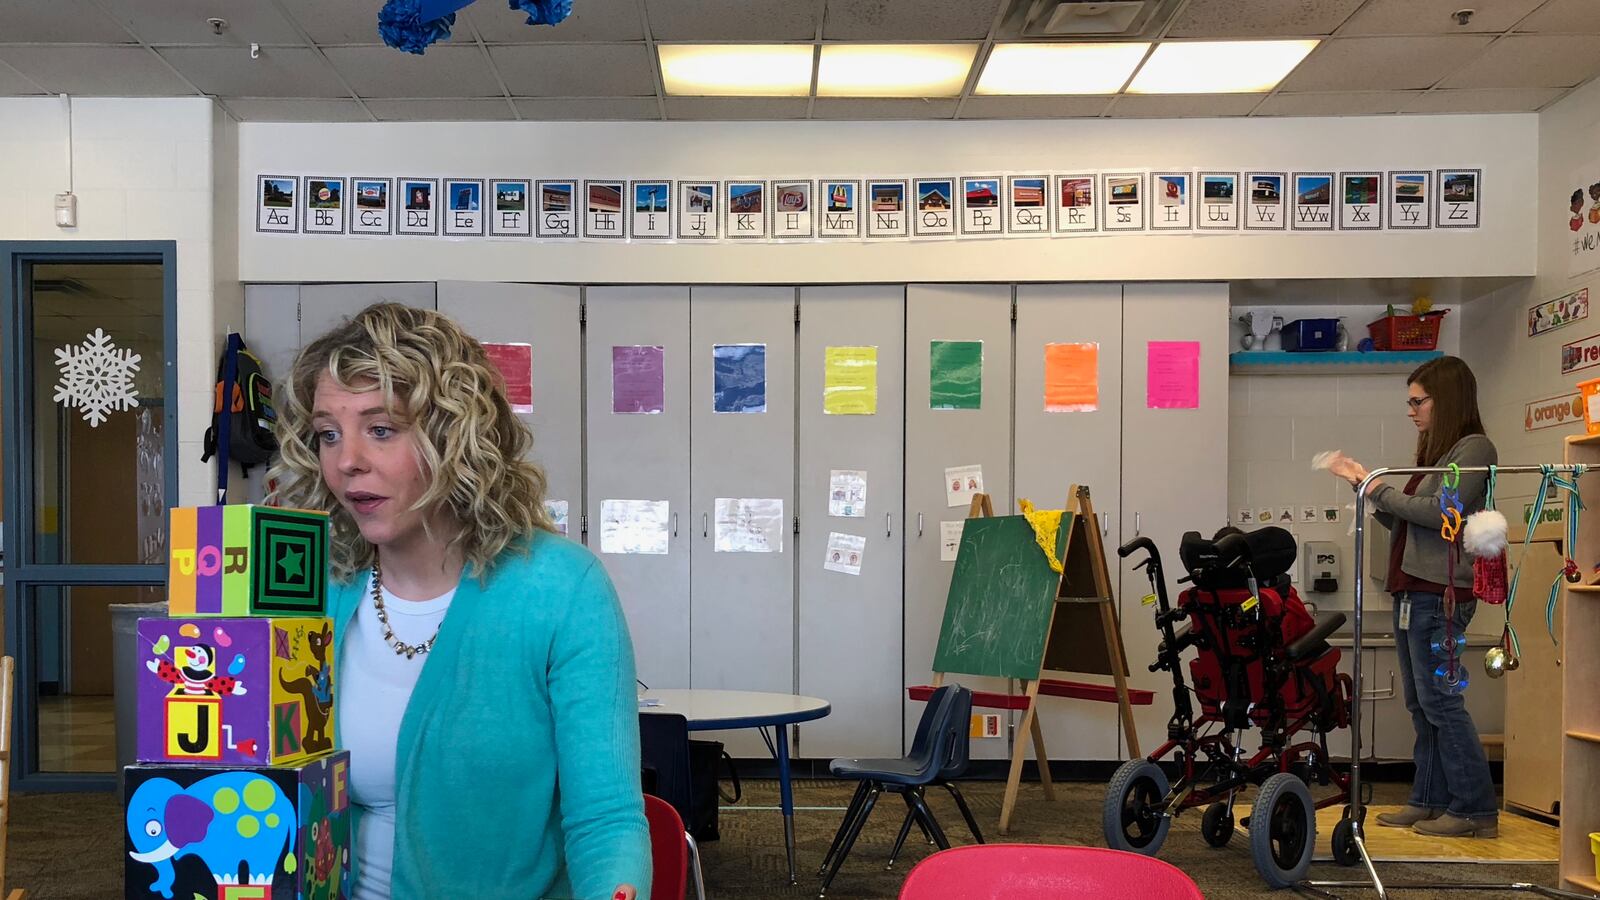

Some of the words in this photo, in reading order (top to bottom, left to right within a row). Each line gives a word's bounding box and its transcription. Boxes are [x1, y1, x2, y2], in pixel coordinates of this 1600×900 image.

[267, 208, 289, 225] Aa
[315, 210, 334, 226] Bb
[360, 210, 382, 226] Cc
[407, 211, 428, 227] Dd
[455, 212, 474, 228] Ee
[502, 212, 520, 228] Ff
[923, 211, 947, 227] Oo
[1016, 208, 1041, 230] Qq
[1068, 208, 1085, 224] Rr
[1116, 206, 1131, 222] Ss
[1164, 206, 1179, 222] Tt
[1208, 204, 1229, 221] Uu
[1256, 205, 1275, 222] Vv
[1298, 206, 1329, 222] Ww
[1352, 205, 1370, 221] Xx
[1400, 204, 1420, 224] Yy
[1448, 203, 1468, 220] Zz
[545, 213, 569, 234] Gg
[595, 213, 615, 230] Hh
[648, 213, 655, 230] Ii
[692, 214, 706, 236] Jj
[738, 214, 755, 230] Kk
[826, 213, 854, 229] Mm
[877, 213, 899, 229] Nn
[973, 210, 992, 231] Pp
[1584, 346, 1600, 362] re
[1534, 402, 1570, 422] orange
[172, 548, 195, 576] P
[196, 545, 222, 577] Q
[224, 547, 248, 574] R
[177, 705, 208, 753] J
[276, 704, 298, 754] K
[333, 762, 345, 812] F
